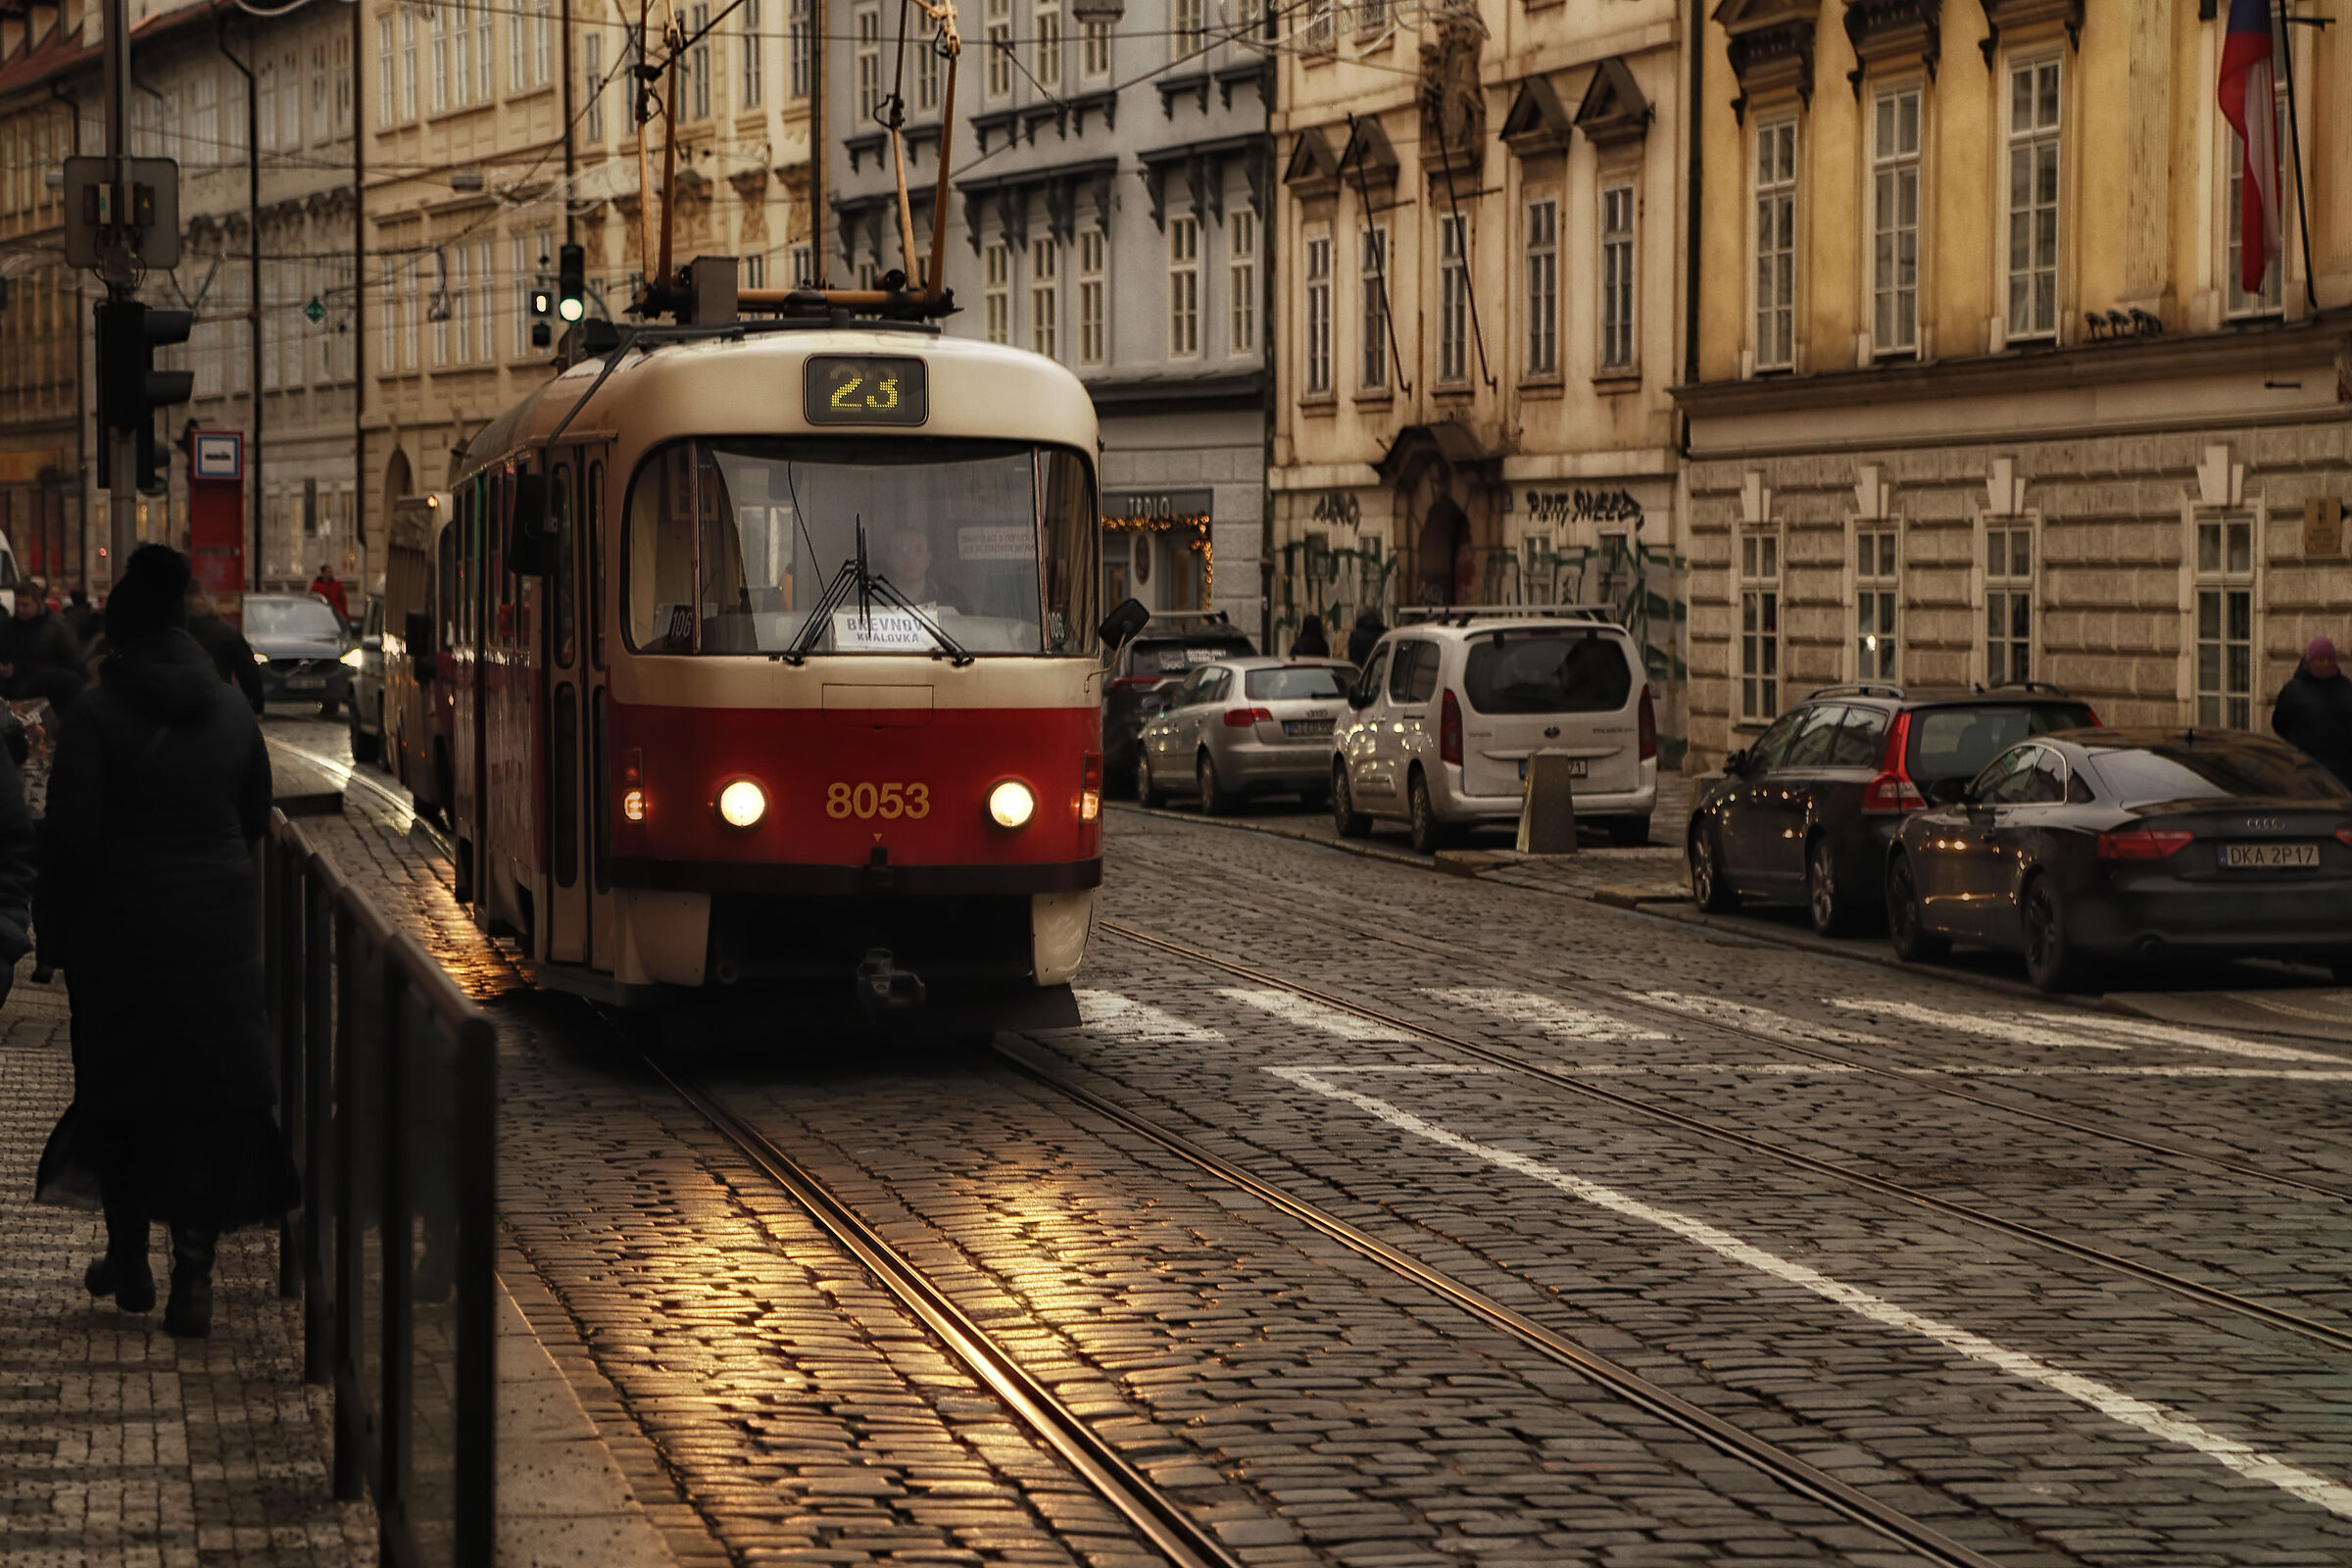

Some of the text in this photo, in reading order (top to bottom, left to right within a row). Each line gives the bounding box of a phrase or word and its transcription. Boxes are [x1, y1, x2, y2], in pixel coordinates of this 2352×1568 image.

[831, 365, 899, 412] 23
[671, 611, 692, 637] 106
[826, 782, 930, 819] 8053
[2230, 846, 2314, 864] DKA 2P17
